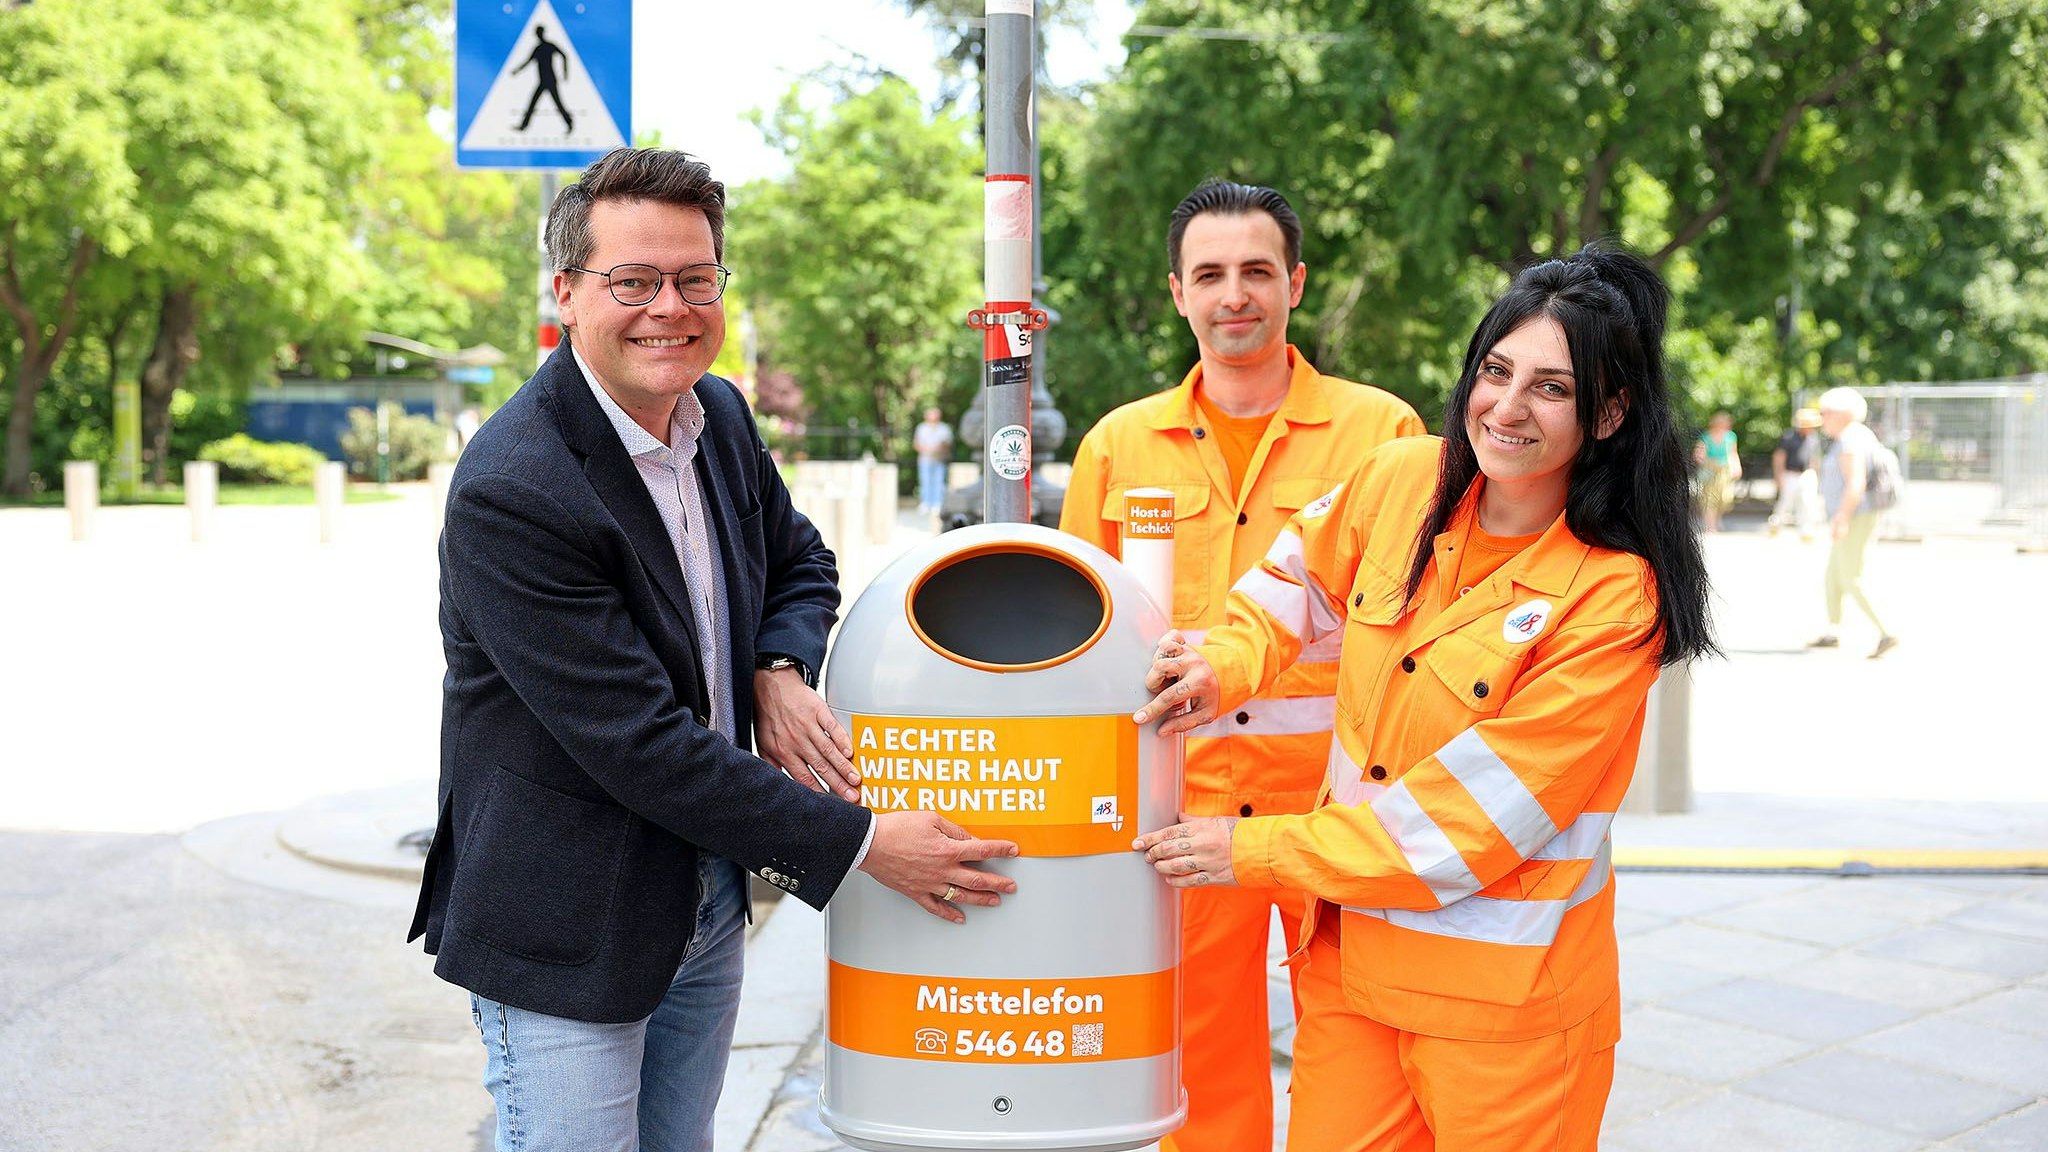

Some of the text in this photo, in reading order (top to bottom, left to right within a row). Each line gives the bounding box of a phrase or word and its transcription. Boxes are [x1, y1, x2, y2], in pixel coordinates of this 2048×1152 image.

[1130, 505, 1160, 518] Host
[859, 726, 997, 752] A ECHTER
[859, 755, 1062, 782] WIENER HAUT
[861, 784, 1046, 811] NIX RUNTER!
[916, 985, 1104, 1015] Misttelefon
[955, 1029, 1066, 1057] 546 48
